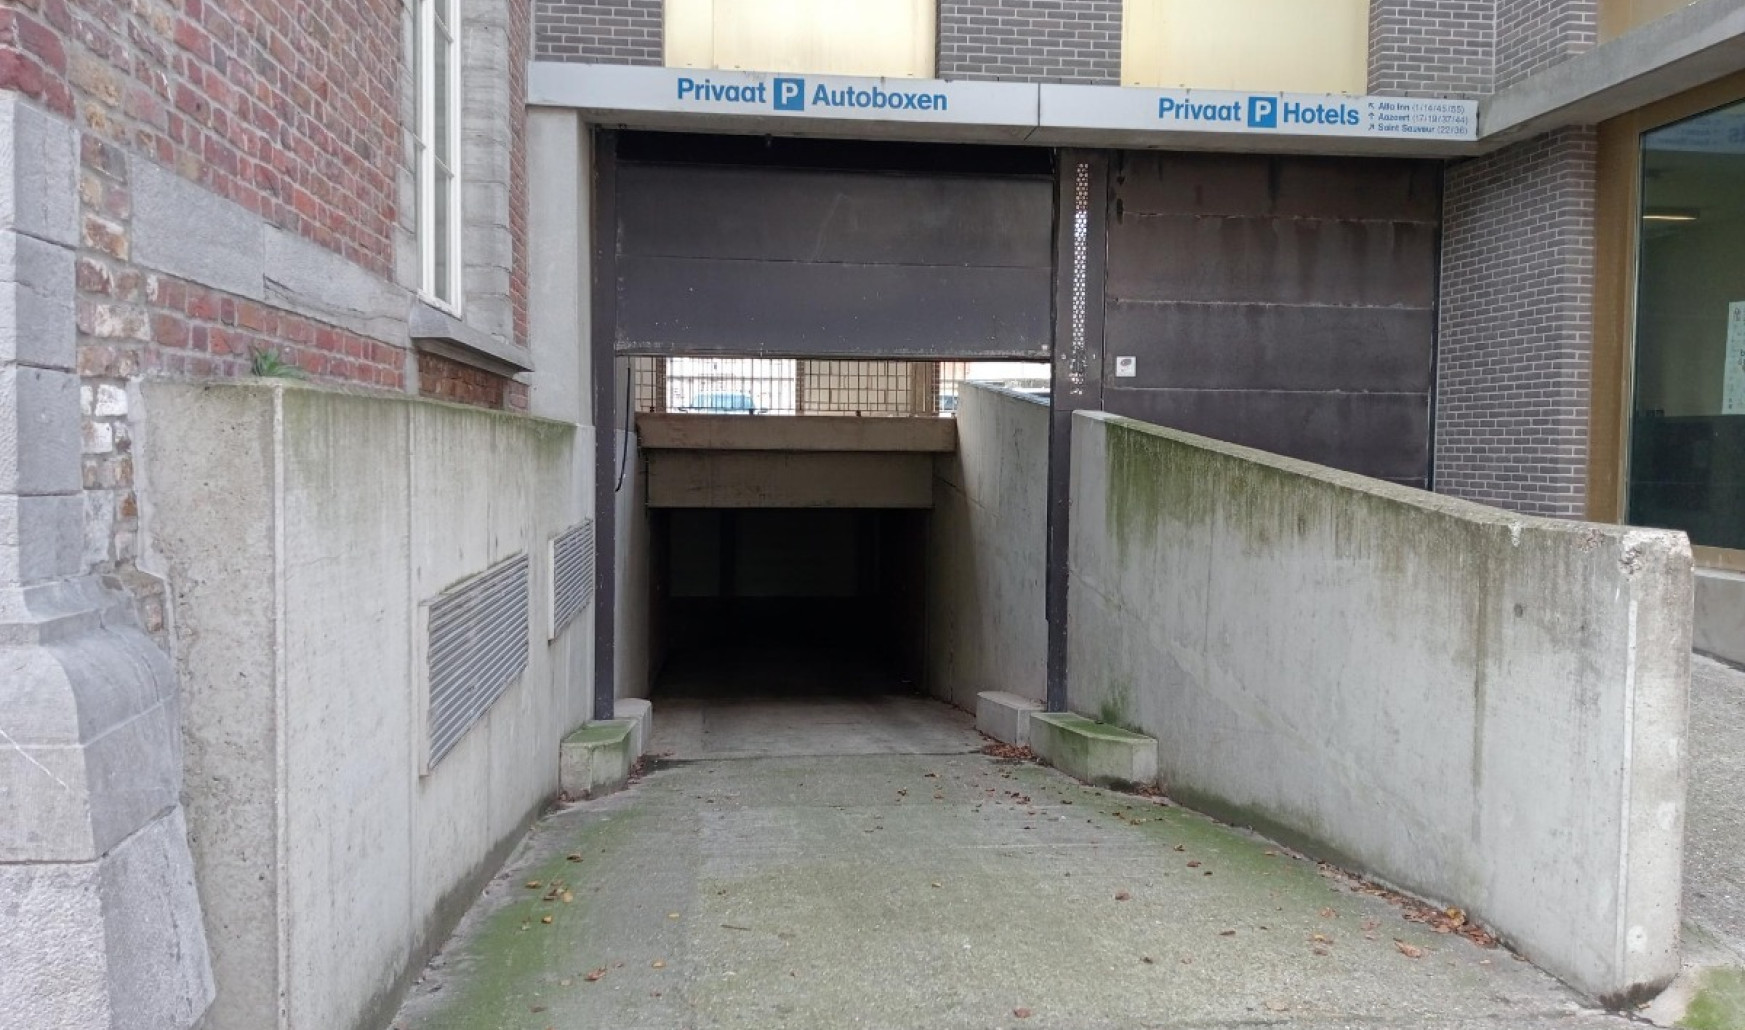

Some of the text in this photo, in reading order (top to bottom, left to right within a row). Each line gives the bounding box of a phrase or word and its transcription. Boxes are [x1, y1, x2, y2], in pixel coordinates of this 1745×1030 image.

[677, 77, 767, 104] Privaat
[811, 83, 948, 111] Autoboxen
[1158, 97, 1242, 122] Privaat
[1283, 102, 1360, 126] Hotels
[1397, 102, 1410, 112] Inn
[1378, 122, 1400, 132] Saint
[1402, 124, 1435, 133] Sauveur
